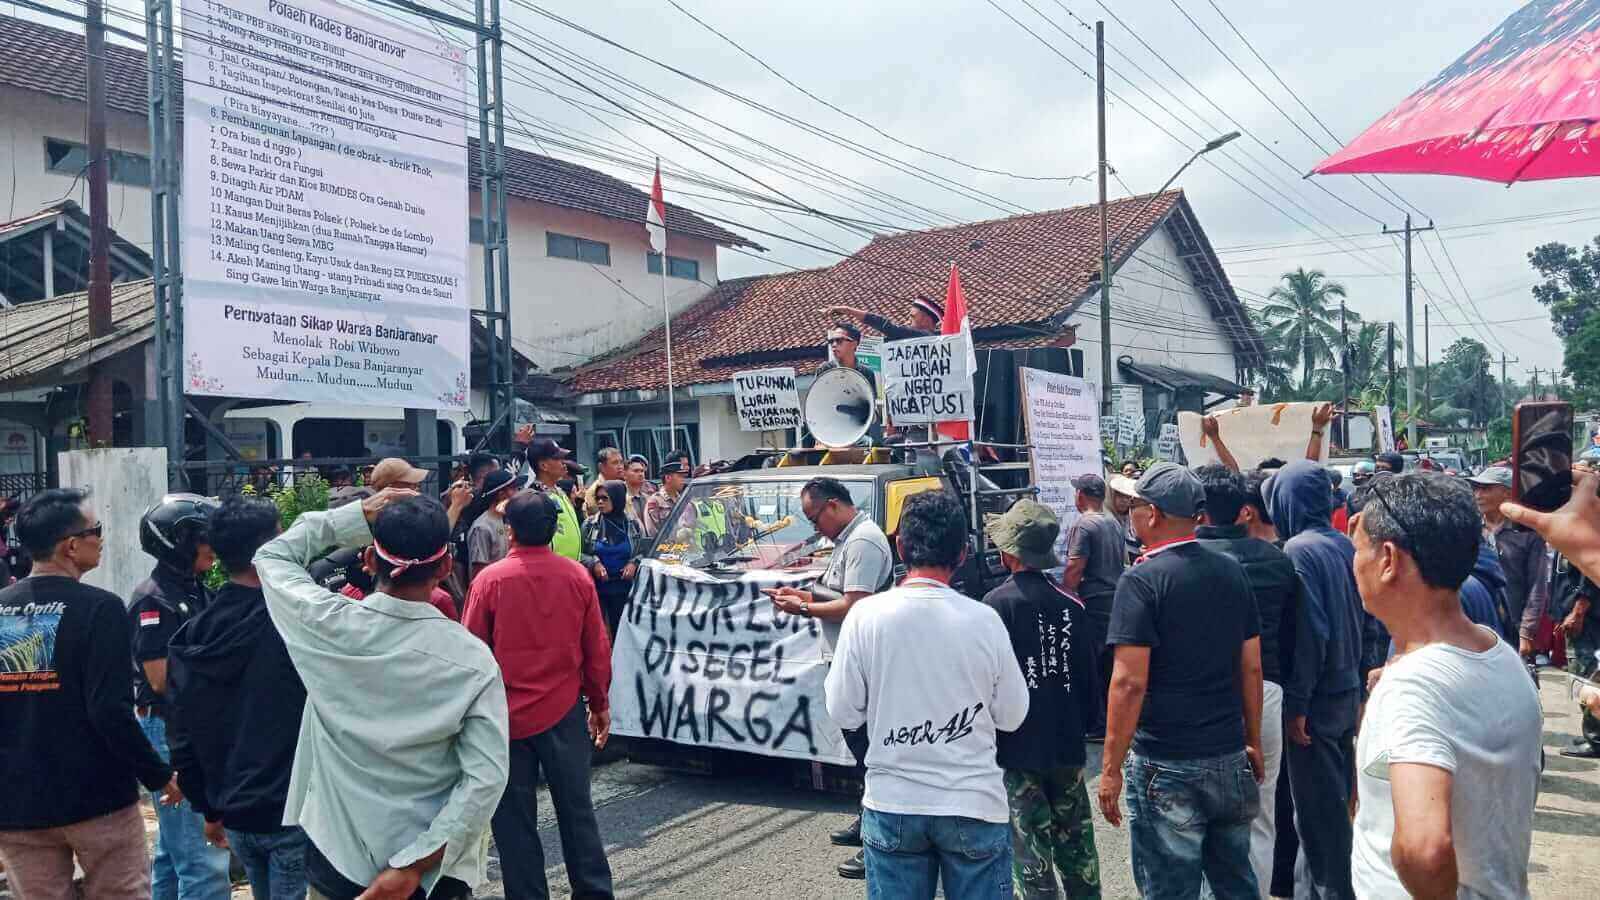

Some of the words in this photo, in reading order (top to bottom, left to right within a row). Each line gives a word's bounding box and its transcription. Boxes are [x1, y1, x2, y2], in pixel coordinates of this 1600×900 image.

[246, 14, 264, 28] PBB
[266, 24, 289, 37] akeh
[268, 0, 306, 24] Polaeh
[310, 12, 342, 37] Kades
[345, 25, 406, 58] Banjaranyar
[220, 49, 239, 64] Jual
[335, 60, 357, 74] MBG
[221, 64, 260, 85] Tagihan
[262, 78, 314, 103] Inspektorat
[315, 96, 346, 113] Senilai
[347, 105, 358, 116] 40
[230, 97, 249, 112] Pira
[220, 126, 239, 139] Ora
[241, 132, 261, 145] bisa
[221, 110, 290, 139] Pembangunan
[292, 129, 336, 151] Lapangan
[343, 145, 355, 156] de
[357, 149, 381, 163] obrak
[389, 158, 411, 171] abrik
[221, 142, 248, 157] Pasar
[250, 149, 272, 164] Indit
[274, 156, 291, 169] Ora
[210, 154, 219, 166] 8.
[221, 158, 247, 173] Sewa
[249, 164, 276, 180] Parkir
[279, 173, 297, 185] dan
[299, 177, 318, 190] Kios
[320, 182, 358, 200] BUMDES
[359, 192, 375, 204] Ora
[377, 196, 403, 211] Genah
[221, 173, 257, 191] Ditagih
[259, 182, 273, 194] Air
[275, 186, 304, 202] PDAM
[224, 189, 264, 208] Mangan
[265, 198, 285, 213] Duit
[286, 204, 311, 218] Beras
[313, 210, 342, 224] Polsek
[350, 218, 377, 233] Polsek
[379, 224, 390, 235] be
[260, 227, 285, 244] Uang
[286, 233, 310, 247] Sewa
[312, 238, 335, 251] MBG
[333, 228, 363, 243] Rumah
[364, 234, 395, 250] Tangga
[226, 252, 254, 267] Akeh
[255, 257, 291, 274] Maning
[293, 263, 320, 279] Utang
[328, 271, 352, 285] utang
[354, 274, 385, 289] Pribadi
[386, 282, 404, 293] sing
[405, 283, 420, 295] Ora
[421, 286, 432, 296] de
[305, 252, 329, 266] Kayu
[330, 256, 353, 269] Usuk
[353, 261, 369, 272] dan
[371, 264, 392, 278] Reng
[393, 268, 406, 279] EX
[407, 270, 453, 287] PUSKESMAS
[226, 268, 249, 283] Sing
[251, 272, 279, 286] Gawe
[281, 276, 298, 289] Isin
[300, 279, 330, 295] Warga
[330, 284, 383, 302] Banjaranyar
[224, 304, 297, 328] Pernyataan
[300, 314, 334, 333] Sikap
[336, 319, 372, 337] Warga
[375, 324, 439, 345] Banjaranyar
[272, 331, 323, 349] Menolak
[329, 337, 355, 353] Robi
[357, 341, 400, 357] Wibowo
[888, 343, 952, 361] JABATAN
[242, 346, 289, 365] Sebagai
[292, 352, 331, 369] Kepala
[334, 355, 361, 370] Desa
[363, 358, 424, 377] Banjaranyar
[901, 358, 951, 378] LURAH
[742, 394, 777, 407] LURAH
[891, 393, 965, 416] NGAPUSI
[23, 600, 67, 617] Optik
[636, 671, 819, 756] WARGA
